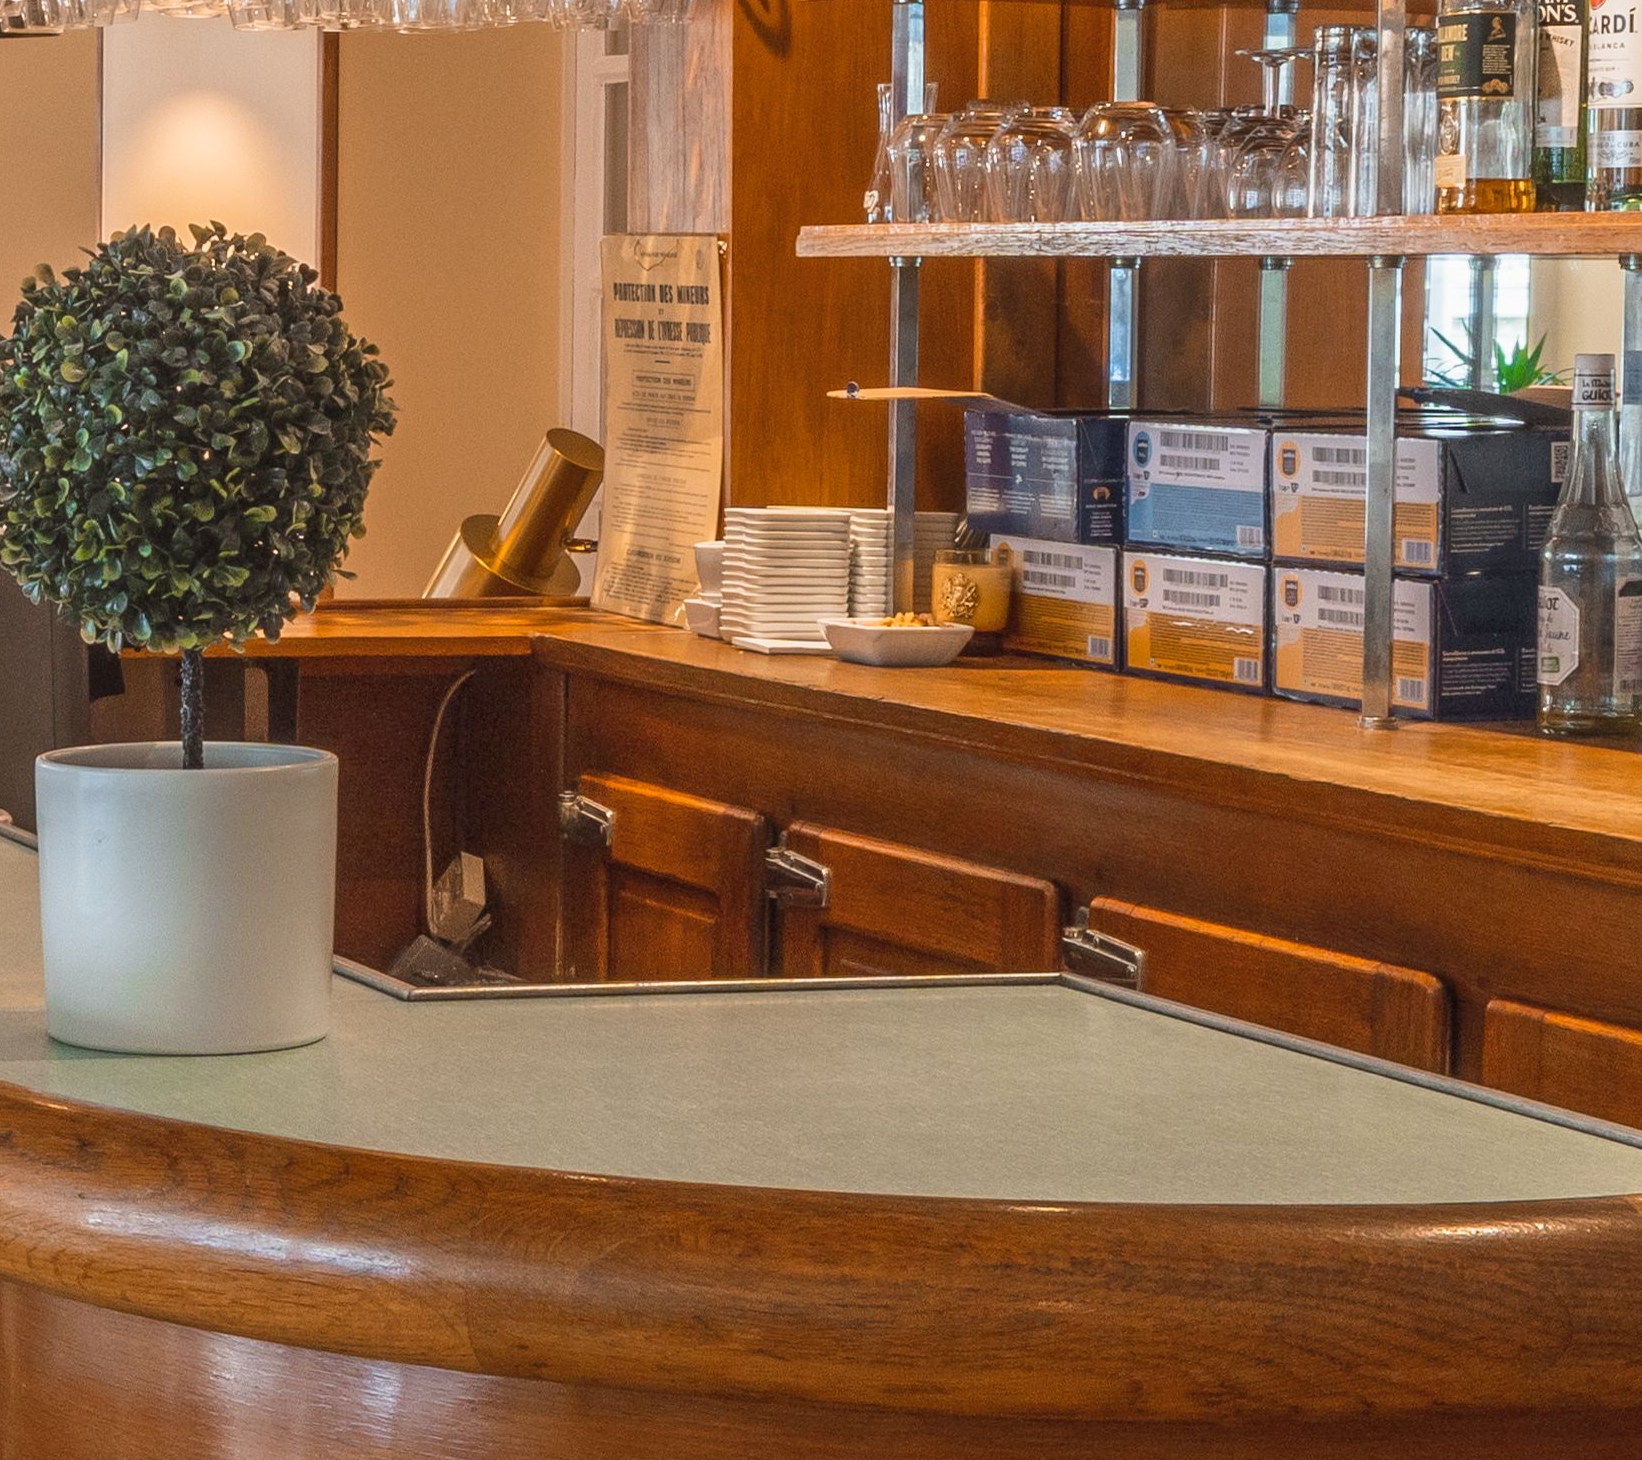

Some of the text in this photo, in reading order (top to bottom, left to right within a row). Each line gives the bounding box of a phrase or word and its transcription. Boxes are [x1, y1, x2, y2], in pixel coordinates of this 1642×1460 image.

[614, 282, 710, 305] PROTECTION DES MINEURS
[648, 320, 655, 341] DE
